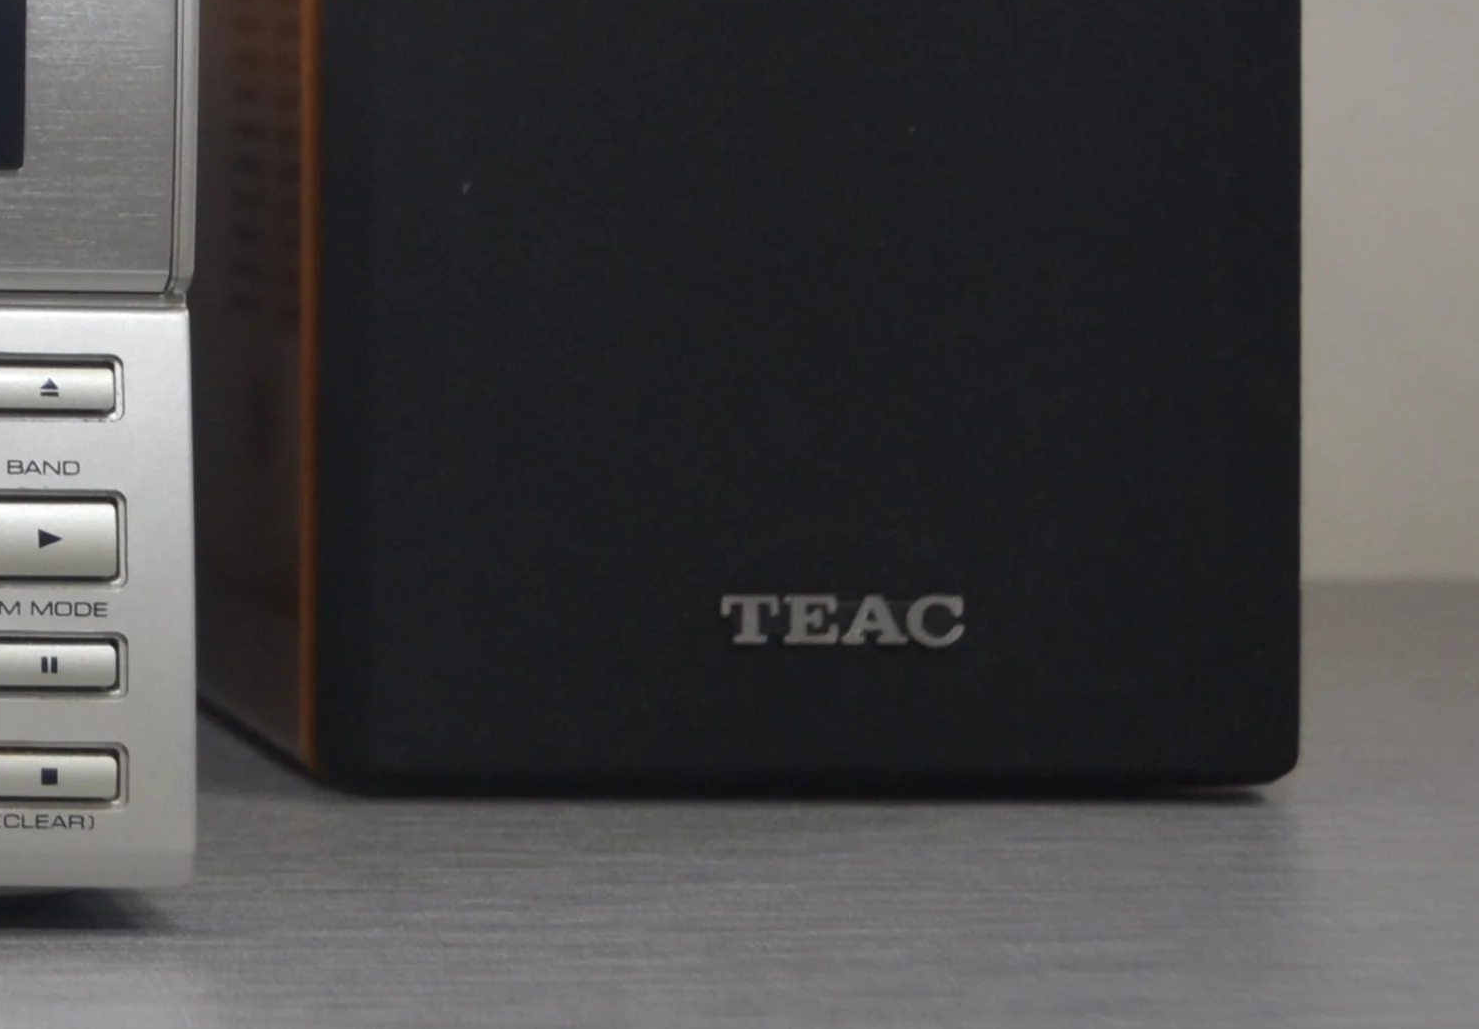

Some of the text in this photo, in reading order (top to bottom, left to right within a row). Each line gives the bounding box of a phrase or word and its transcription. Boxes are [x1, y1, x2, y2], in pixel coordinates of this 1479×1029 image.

[7, 459, 81, 476] BAND
[30, 600, 109, 618] MODE
[719, 592, 966, 649] TEAC
